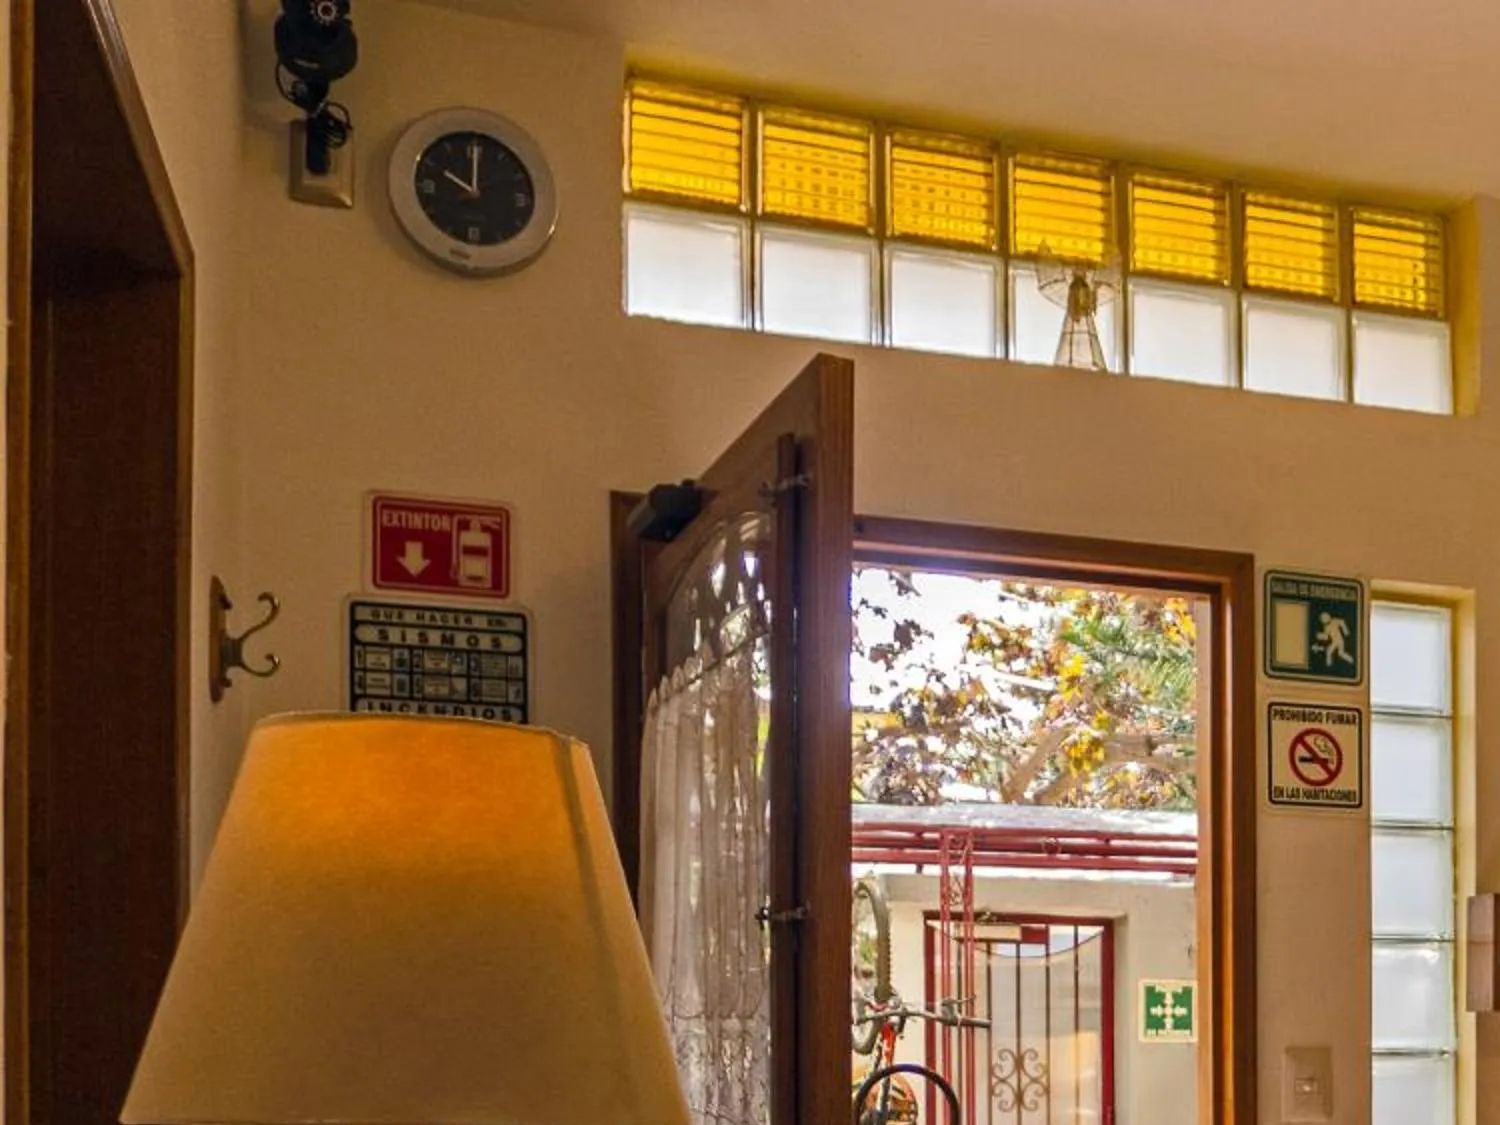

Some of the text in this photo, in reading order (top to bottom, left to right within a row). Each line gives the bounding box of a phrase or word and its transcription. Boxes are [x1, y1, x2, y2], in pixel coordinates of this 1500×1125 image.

[382, 509, 451, 531] EXTINTOR
[416, 612, 473, 625] HACER
[378, 629, 502, 648] SISMOS
[1273, 708, 1357, 725] PROHIBIDO FUMAR
[1273, 786, 1357, 802] EN LAS HABITACIONES
